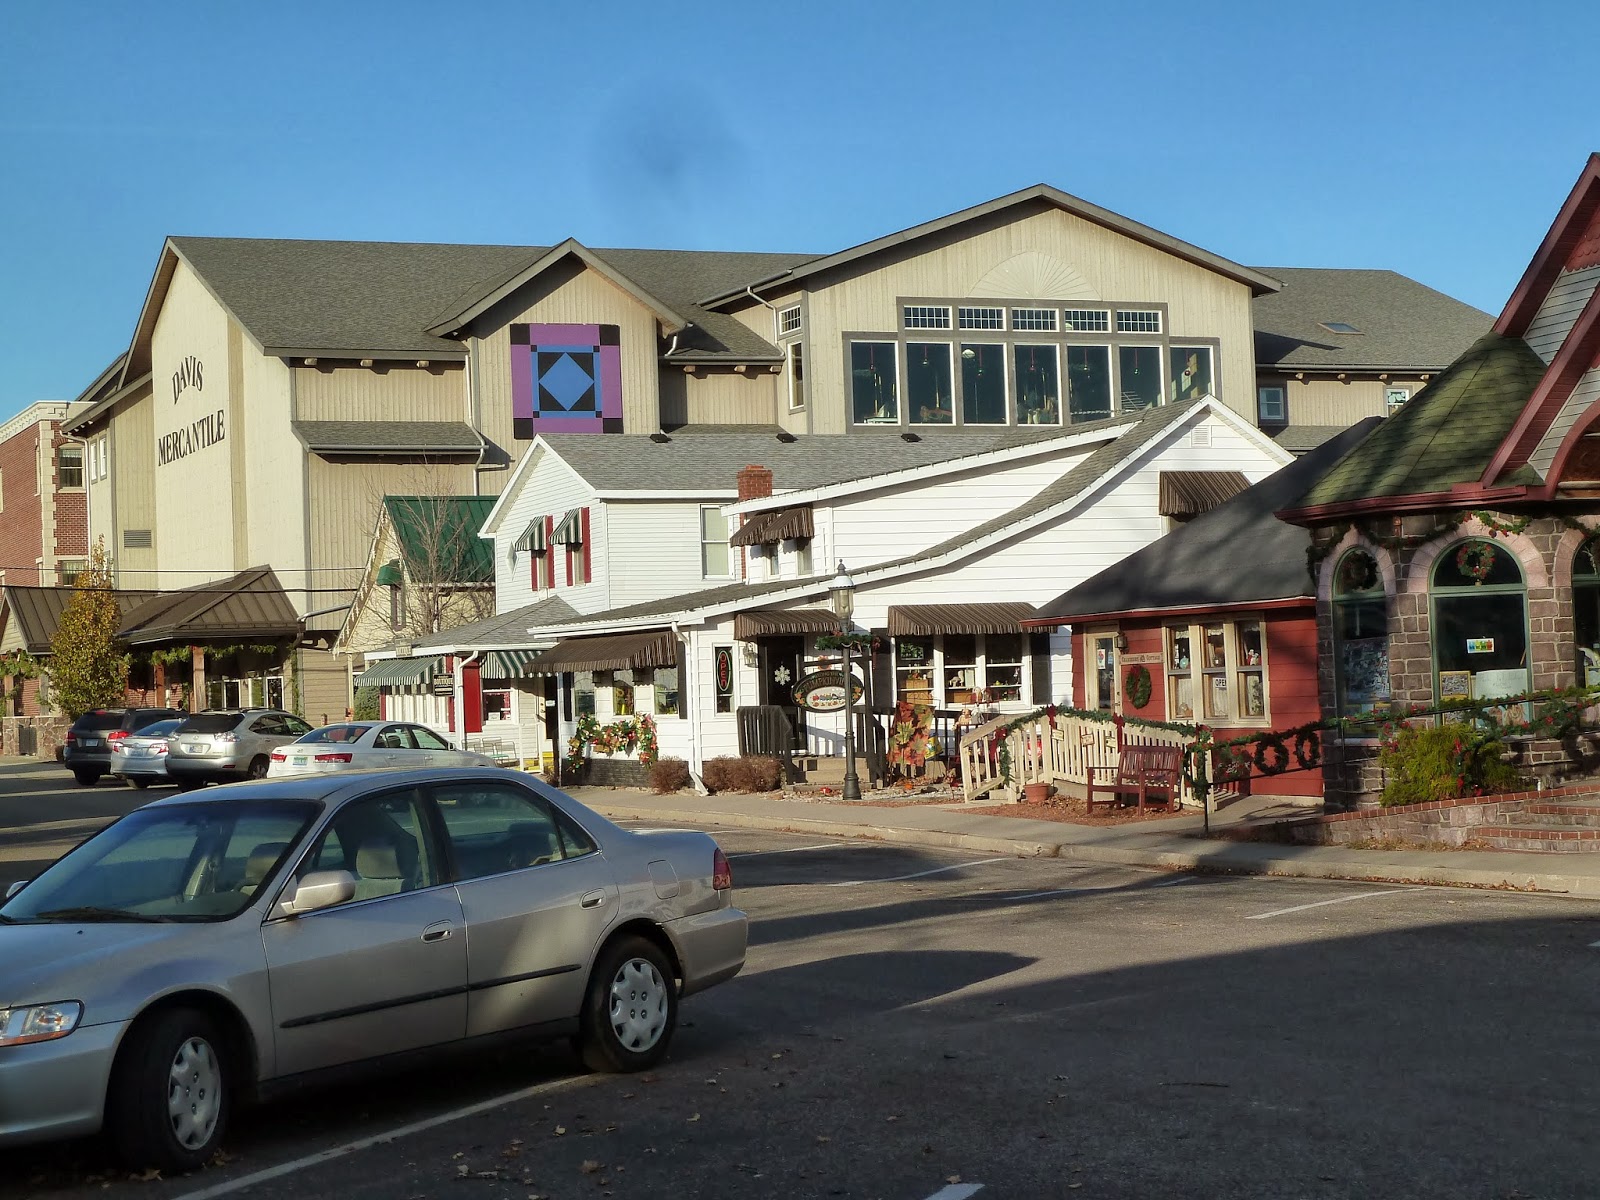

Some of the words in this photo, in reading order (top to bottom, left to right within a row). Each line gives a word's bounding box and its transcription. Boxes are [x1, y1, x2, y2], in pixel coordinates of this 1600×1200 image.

[172, 355, 203, 405] DAVIS
[158, 409, 226, 467] MERCANTILE
[803, 676, 835, 692] PUMPKIN
